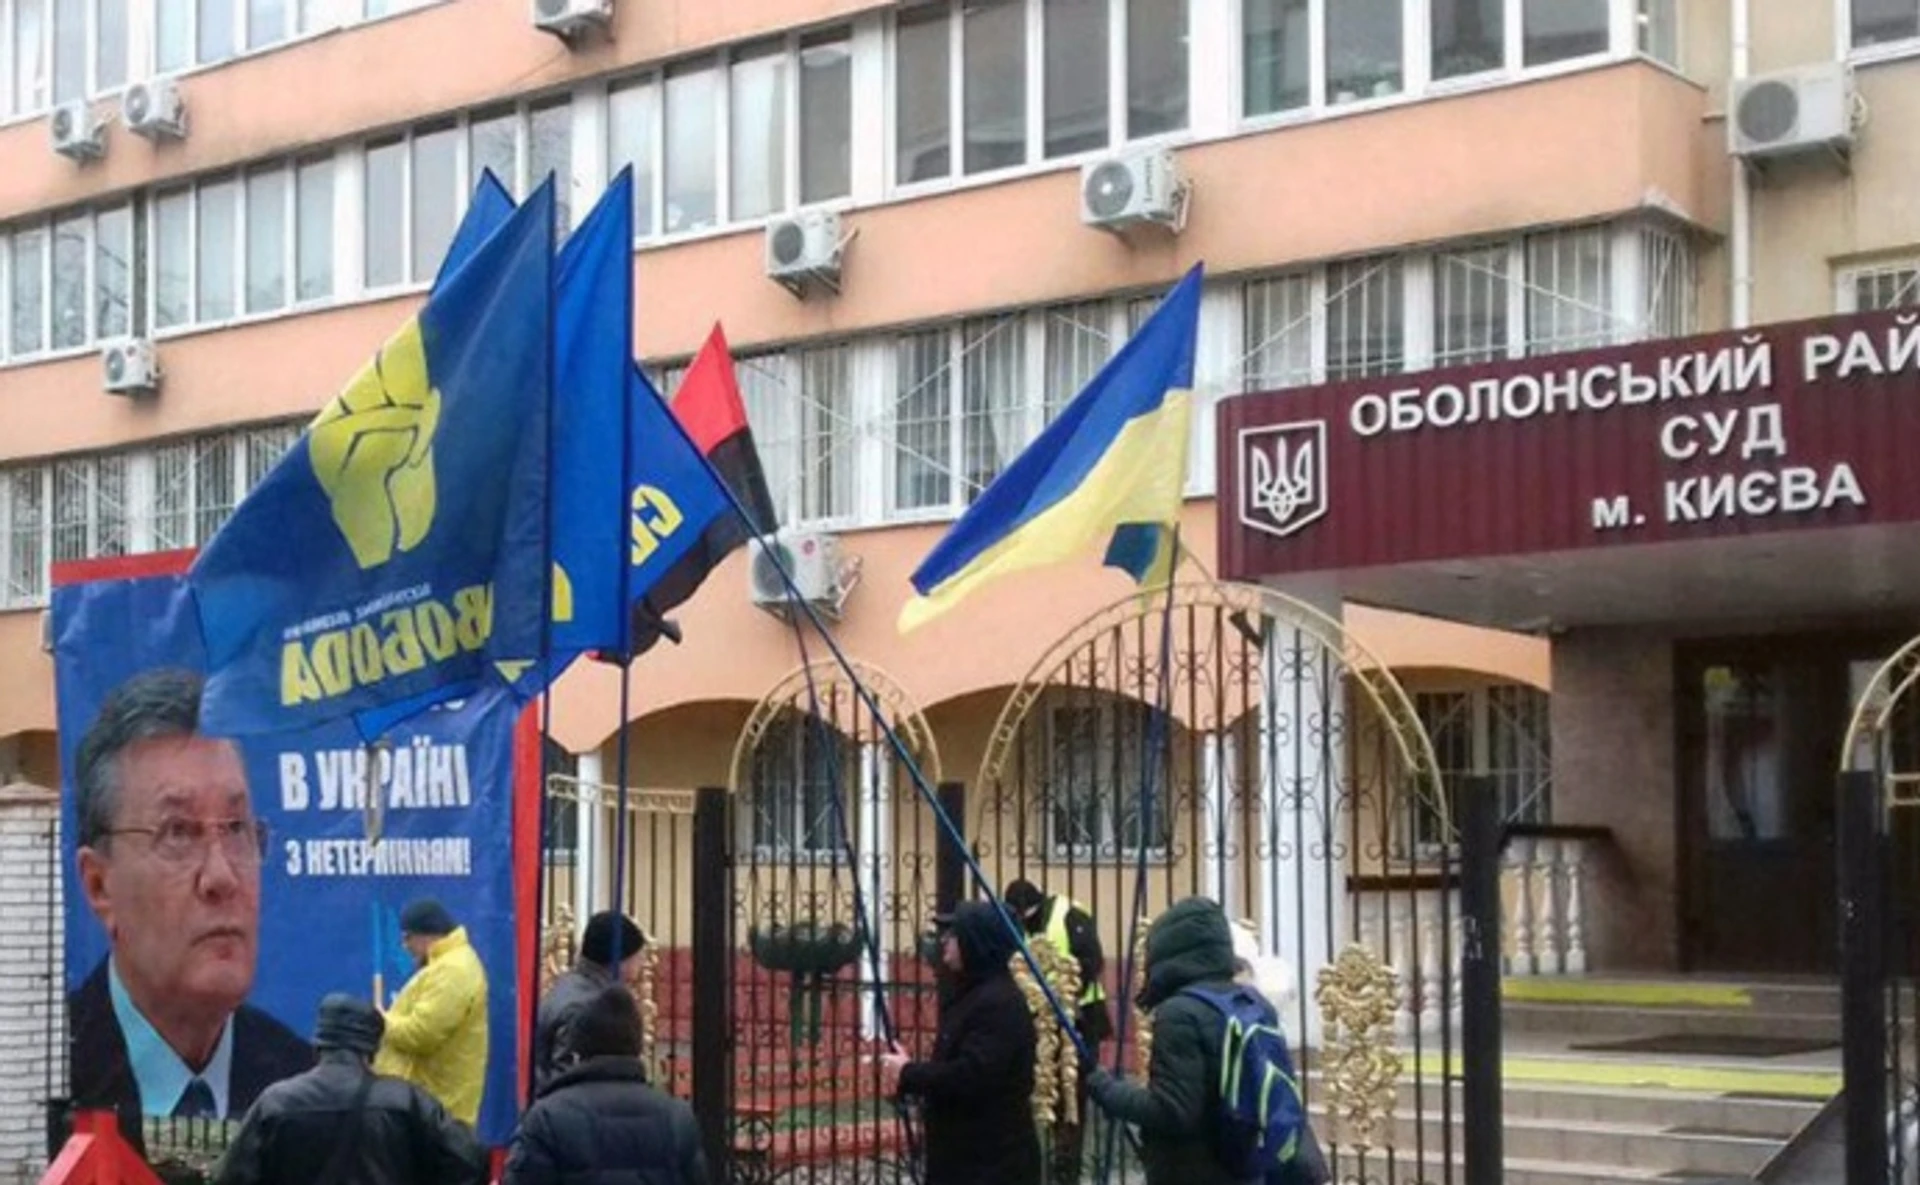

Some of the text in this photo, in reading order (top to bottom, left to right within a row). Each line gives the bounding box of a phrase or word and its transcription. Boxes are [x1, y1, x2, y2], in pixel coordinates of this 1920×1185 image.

[1350, 312, 1920, 437] ОБОЛОНСЬКИЙ РАЙ
[1659, 402, 1787, 460] СУД
[1591, 461, 1867, 529] м. КИЄВА
[278, 734, 472, 812] В УКРАЇНІ
